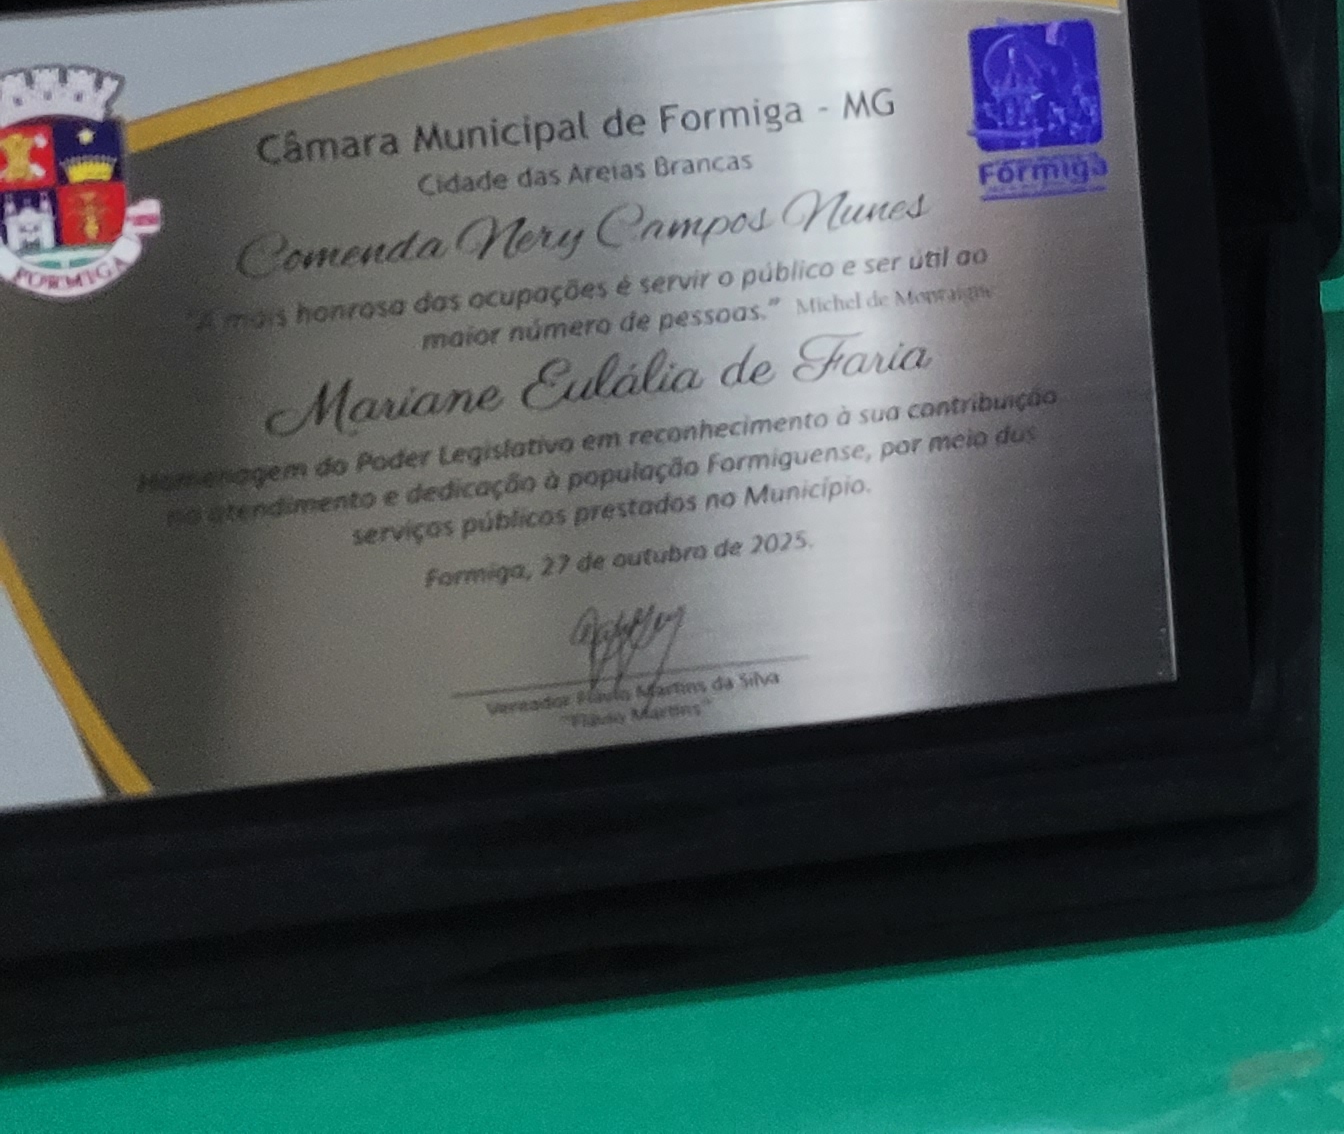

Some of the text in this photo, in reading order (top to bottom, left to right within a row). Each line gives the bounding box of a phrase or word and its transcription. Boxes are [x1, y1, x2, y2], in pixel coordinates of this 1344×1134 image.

[255, 129, 400, 166] Câmara
[413, 110, 589, 153] Municipal
[602, 107, 647, 138] de
[659, 98, 803, 134] Formiga
[843, 87, 895, 120] MG
[264, 332, 933, 438] Mariane Eulália de Faria
